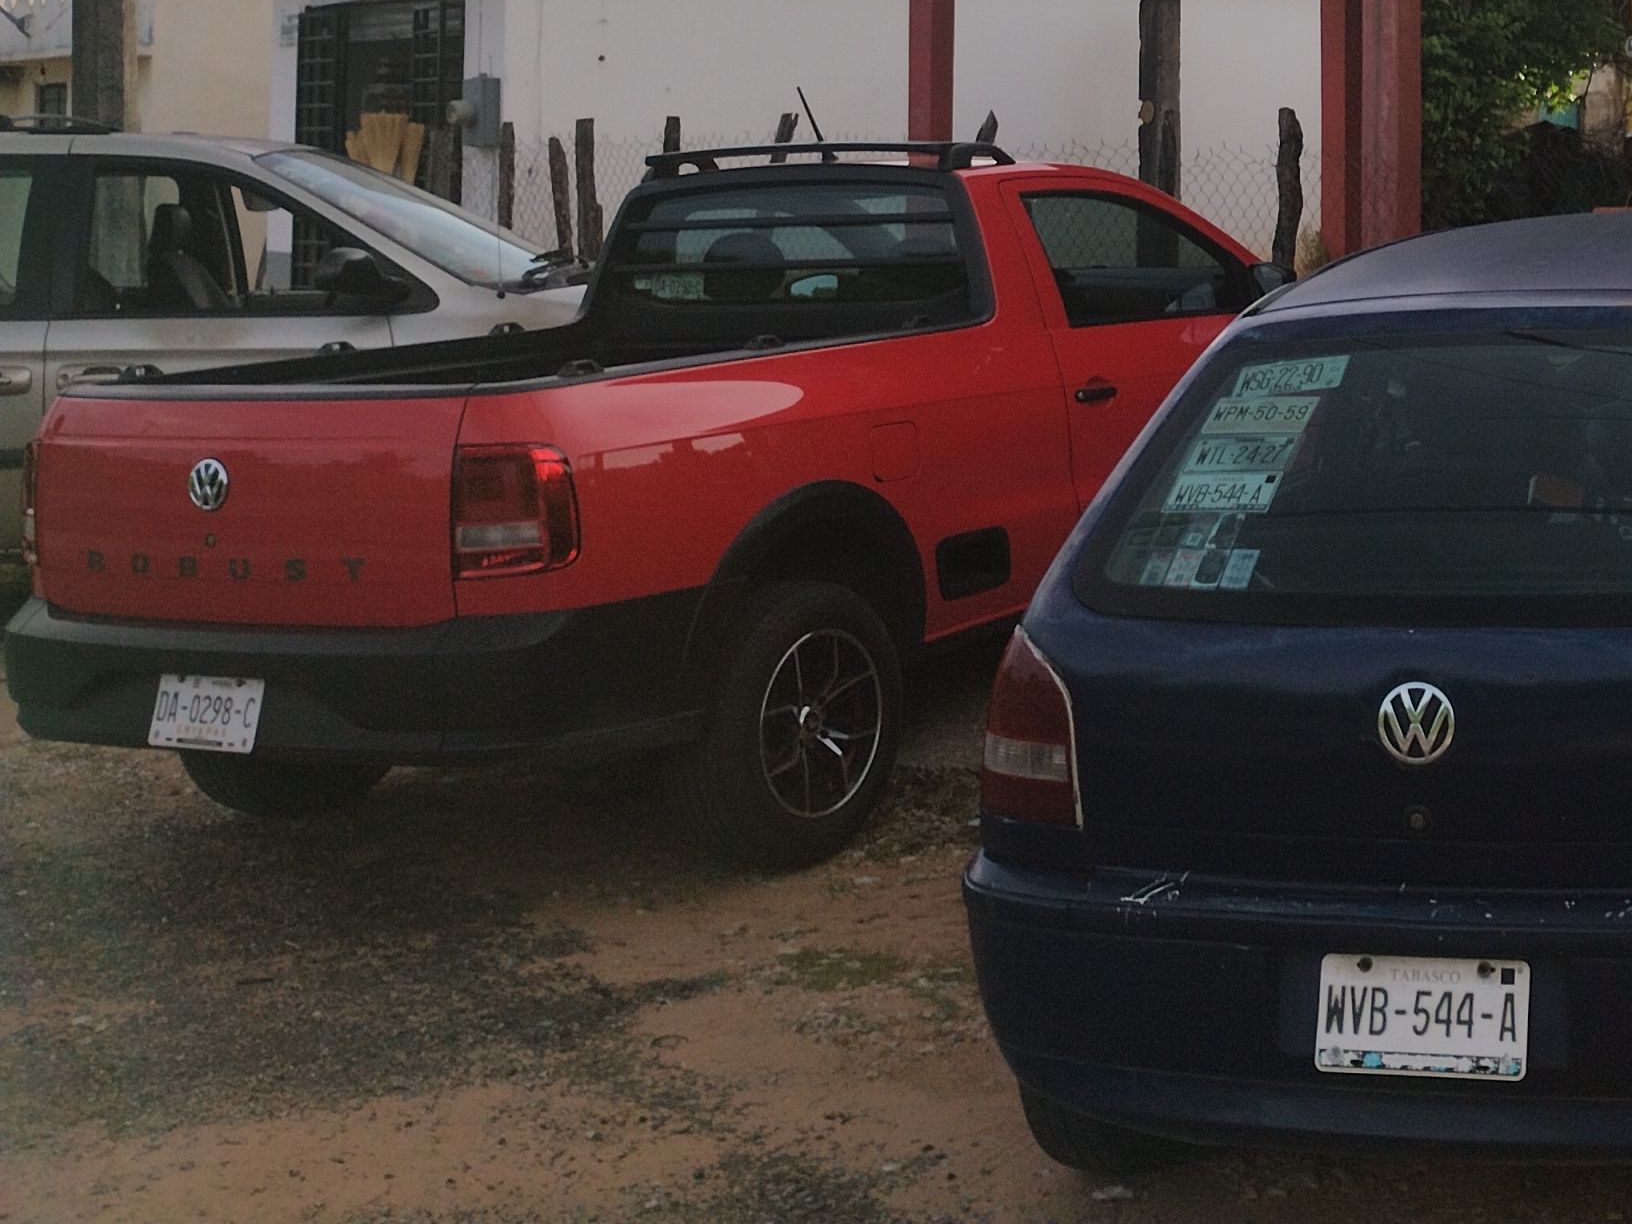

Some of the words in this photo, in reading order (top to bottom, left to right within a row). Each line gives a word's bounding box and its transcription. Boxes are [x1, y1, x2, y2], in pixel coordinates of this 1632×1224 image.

[1213, 405, 1309, 421] WPM-50-59
[1196, 444, 1286, 465] WTL-24-27
[1175, 483, 1262, 504] WVB-544-A
[87, 550, 366, 580] ROBUST
[156, 690, 256, 728] DA-0298-C
[1390, 968, 1462, 985] TABASCO
[1325, 985, 1517, 1042] WVB-544-A
